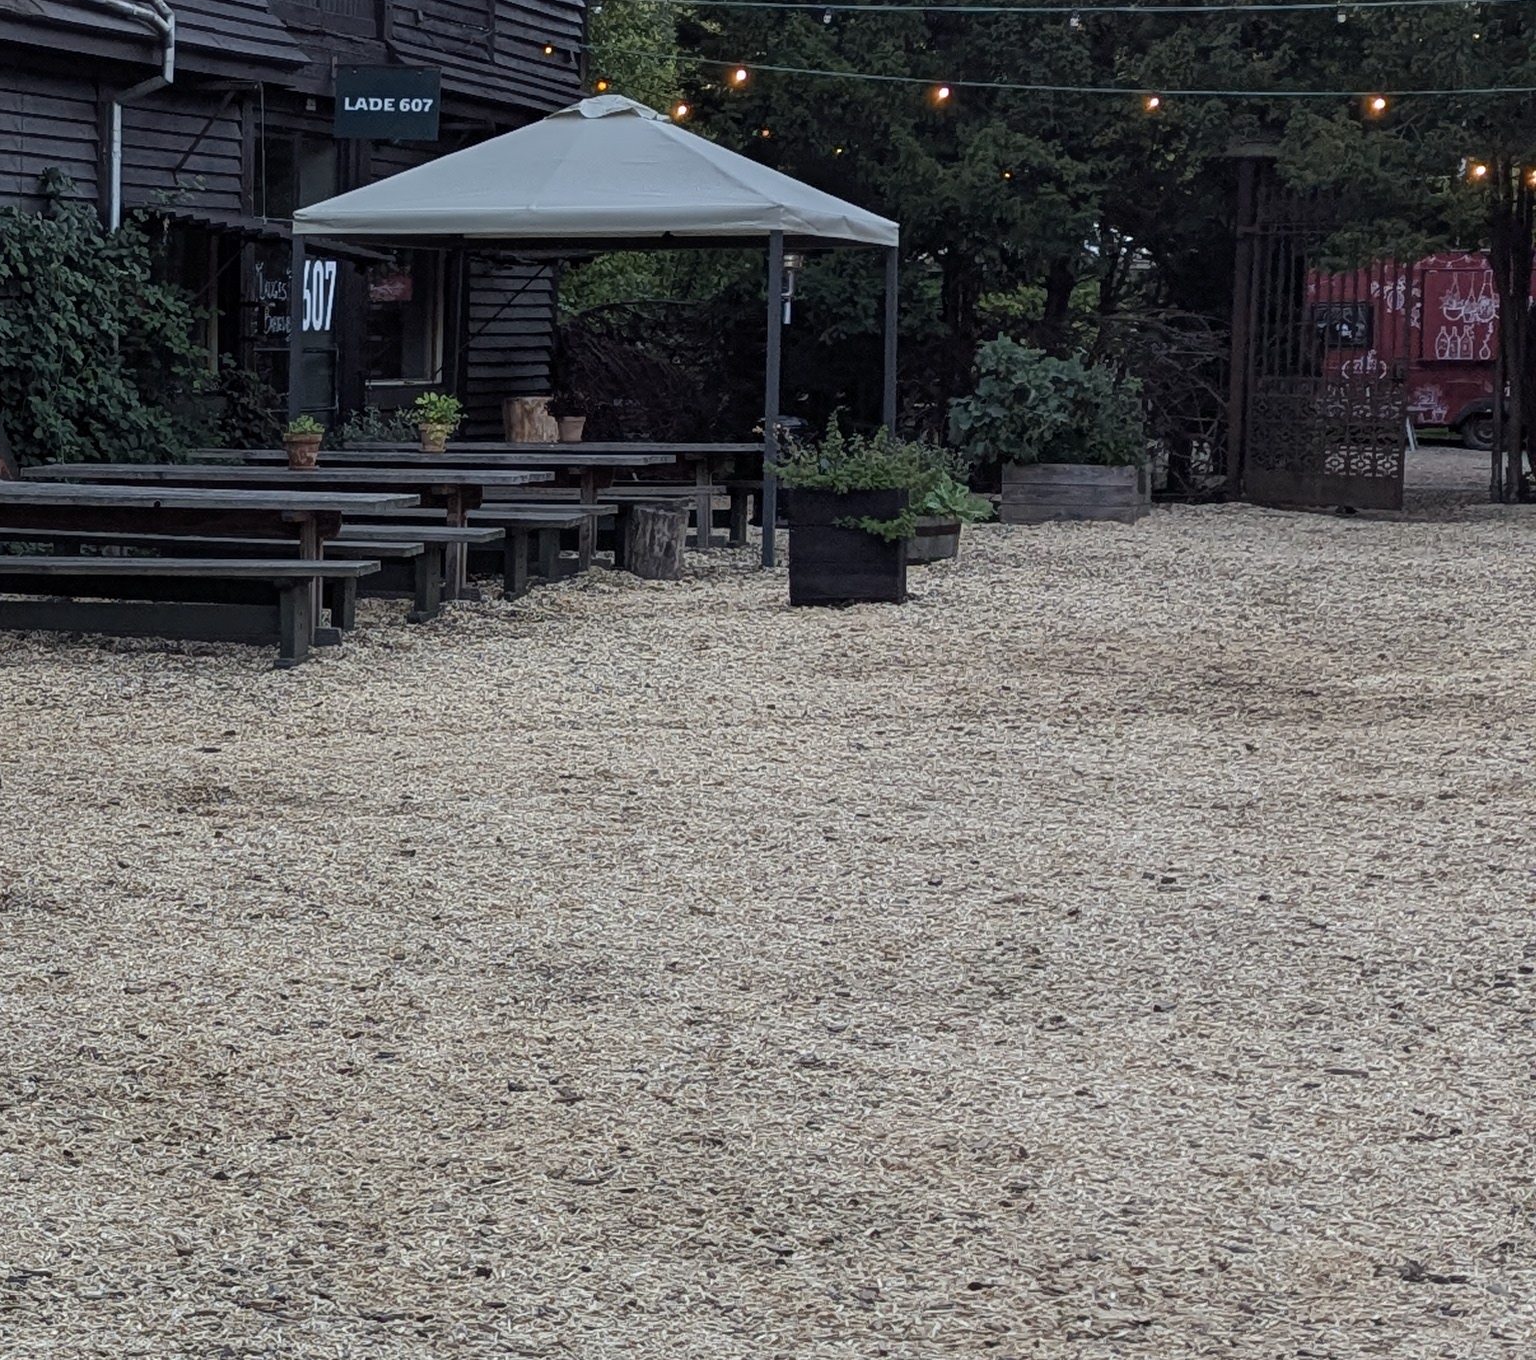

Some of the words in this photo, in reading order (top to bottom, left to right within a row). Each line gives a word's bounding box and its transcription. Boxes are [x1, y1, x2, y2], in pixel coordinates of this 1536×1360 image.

[344, 97, 395, 112] LADE
[399, 98, 434, 112] 607
[302, 260, 337, 331] 607
